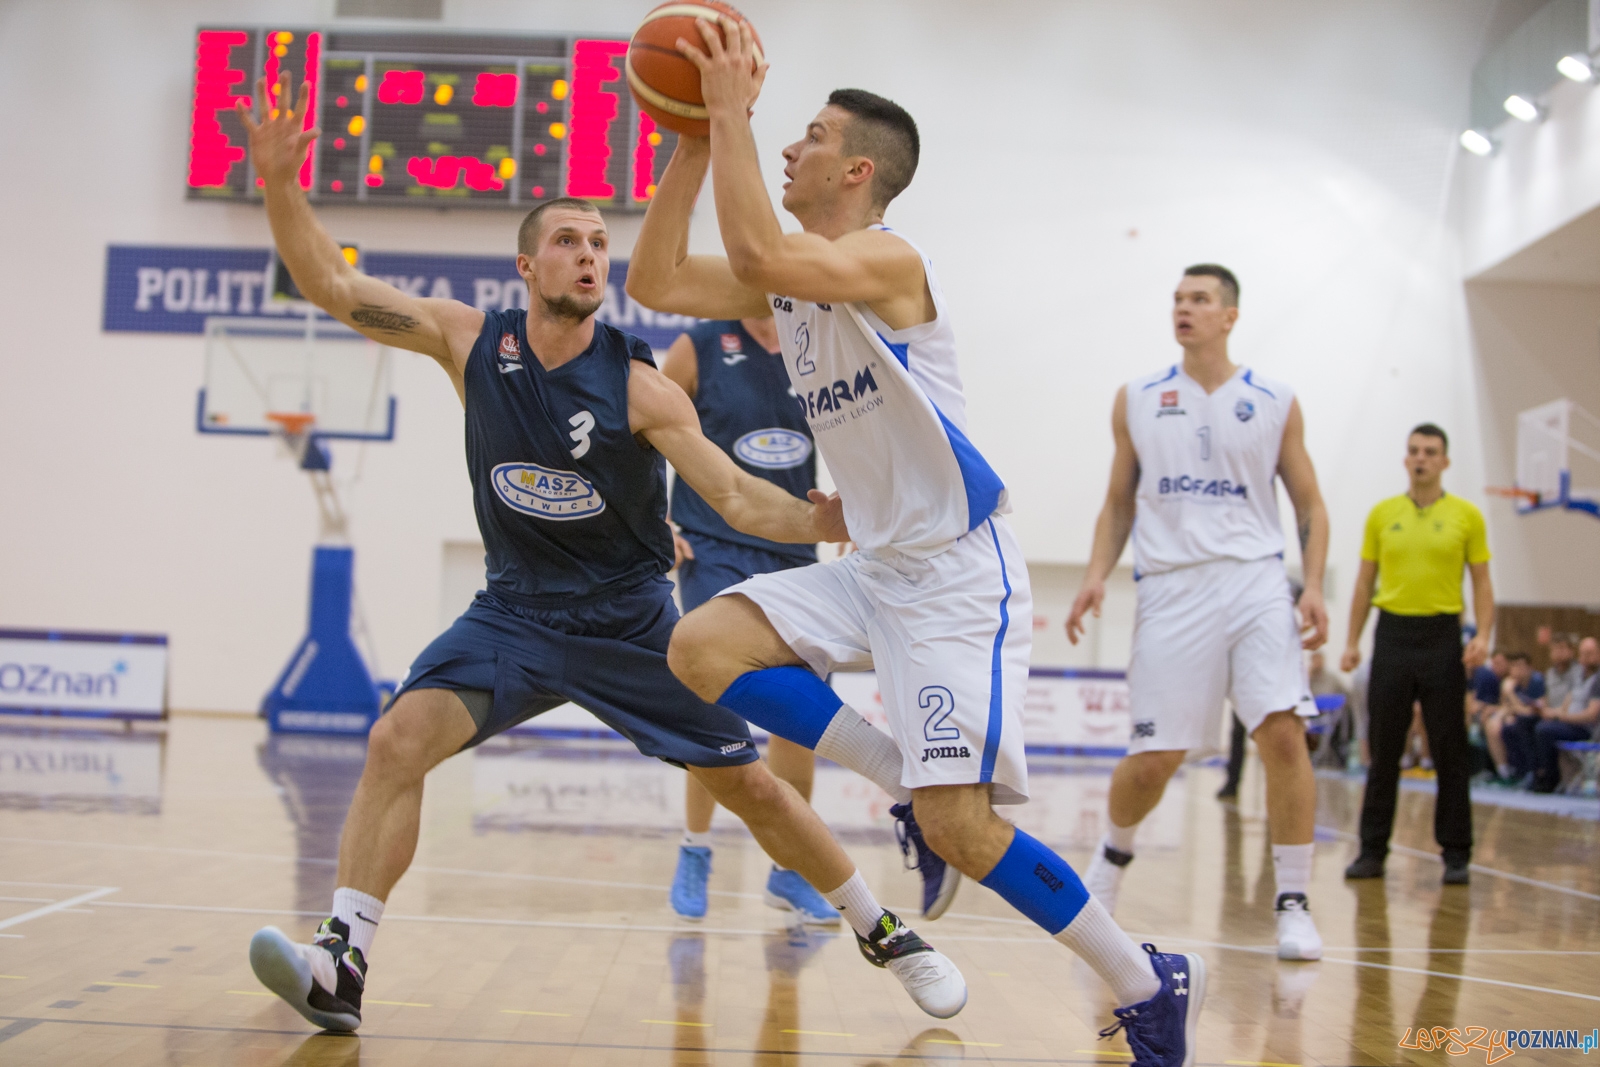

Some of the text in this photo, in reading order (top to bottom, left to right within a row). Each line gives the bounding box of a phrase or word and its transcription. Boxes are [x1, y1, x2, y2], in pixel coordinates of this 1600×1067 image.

[795, 321, 817, 376] 2
[567, 410, 595, 460] 3
[1196, 424, 1212, 462] 1
[503, 485, 593, 512] GLIWICE
[520, 470, 578, 492] MASZ
[524, 484, 573, 497] MALINOWSKI
[918, 685, 960, 742] 2
